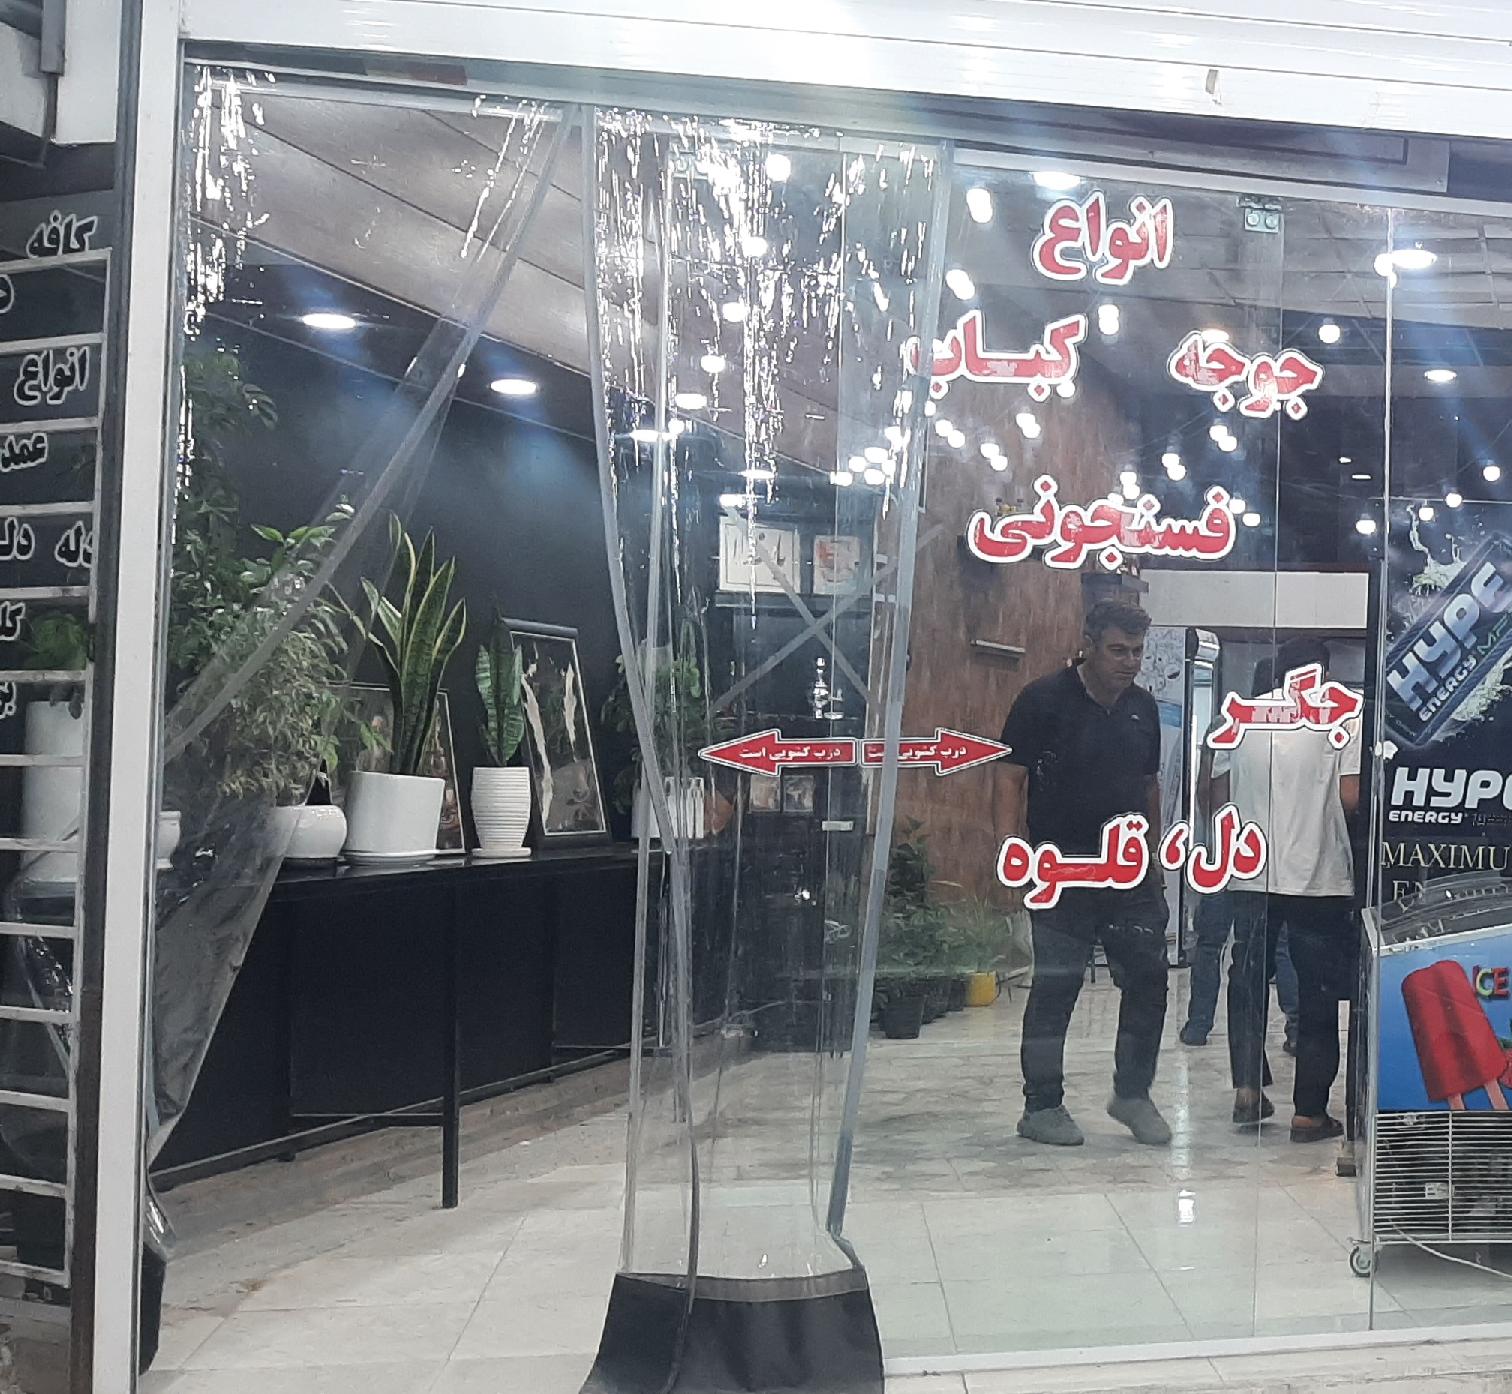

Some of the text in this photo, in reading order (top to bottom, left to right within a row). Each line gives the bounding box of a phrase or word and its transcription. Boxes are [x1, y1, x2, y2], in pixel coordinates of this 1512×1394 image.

[26, 210, 98, 258] کافه
[1032, 191, 1173, 285] انواع
[14, 346, 89, 406] انواع
[904, 310, 1323, 419] جوجه کباب
[968, 476, 1236, 568] فسنجونی
[1206, 662, 1365, 750] جگر
[996, 811, 1149, 909] قلوه
[1388, 810, 1463, 824] ENERGY
[1472, 965, 1510, 998] ICE
